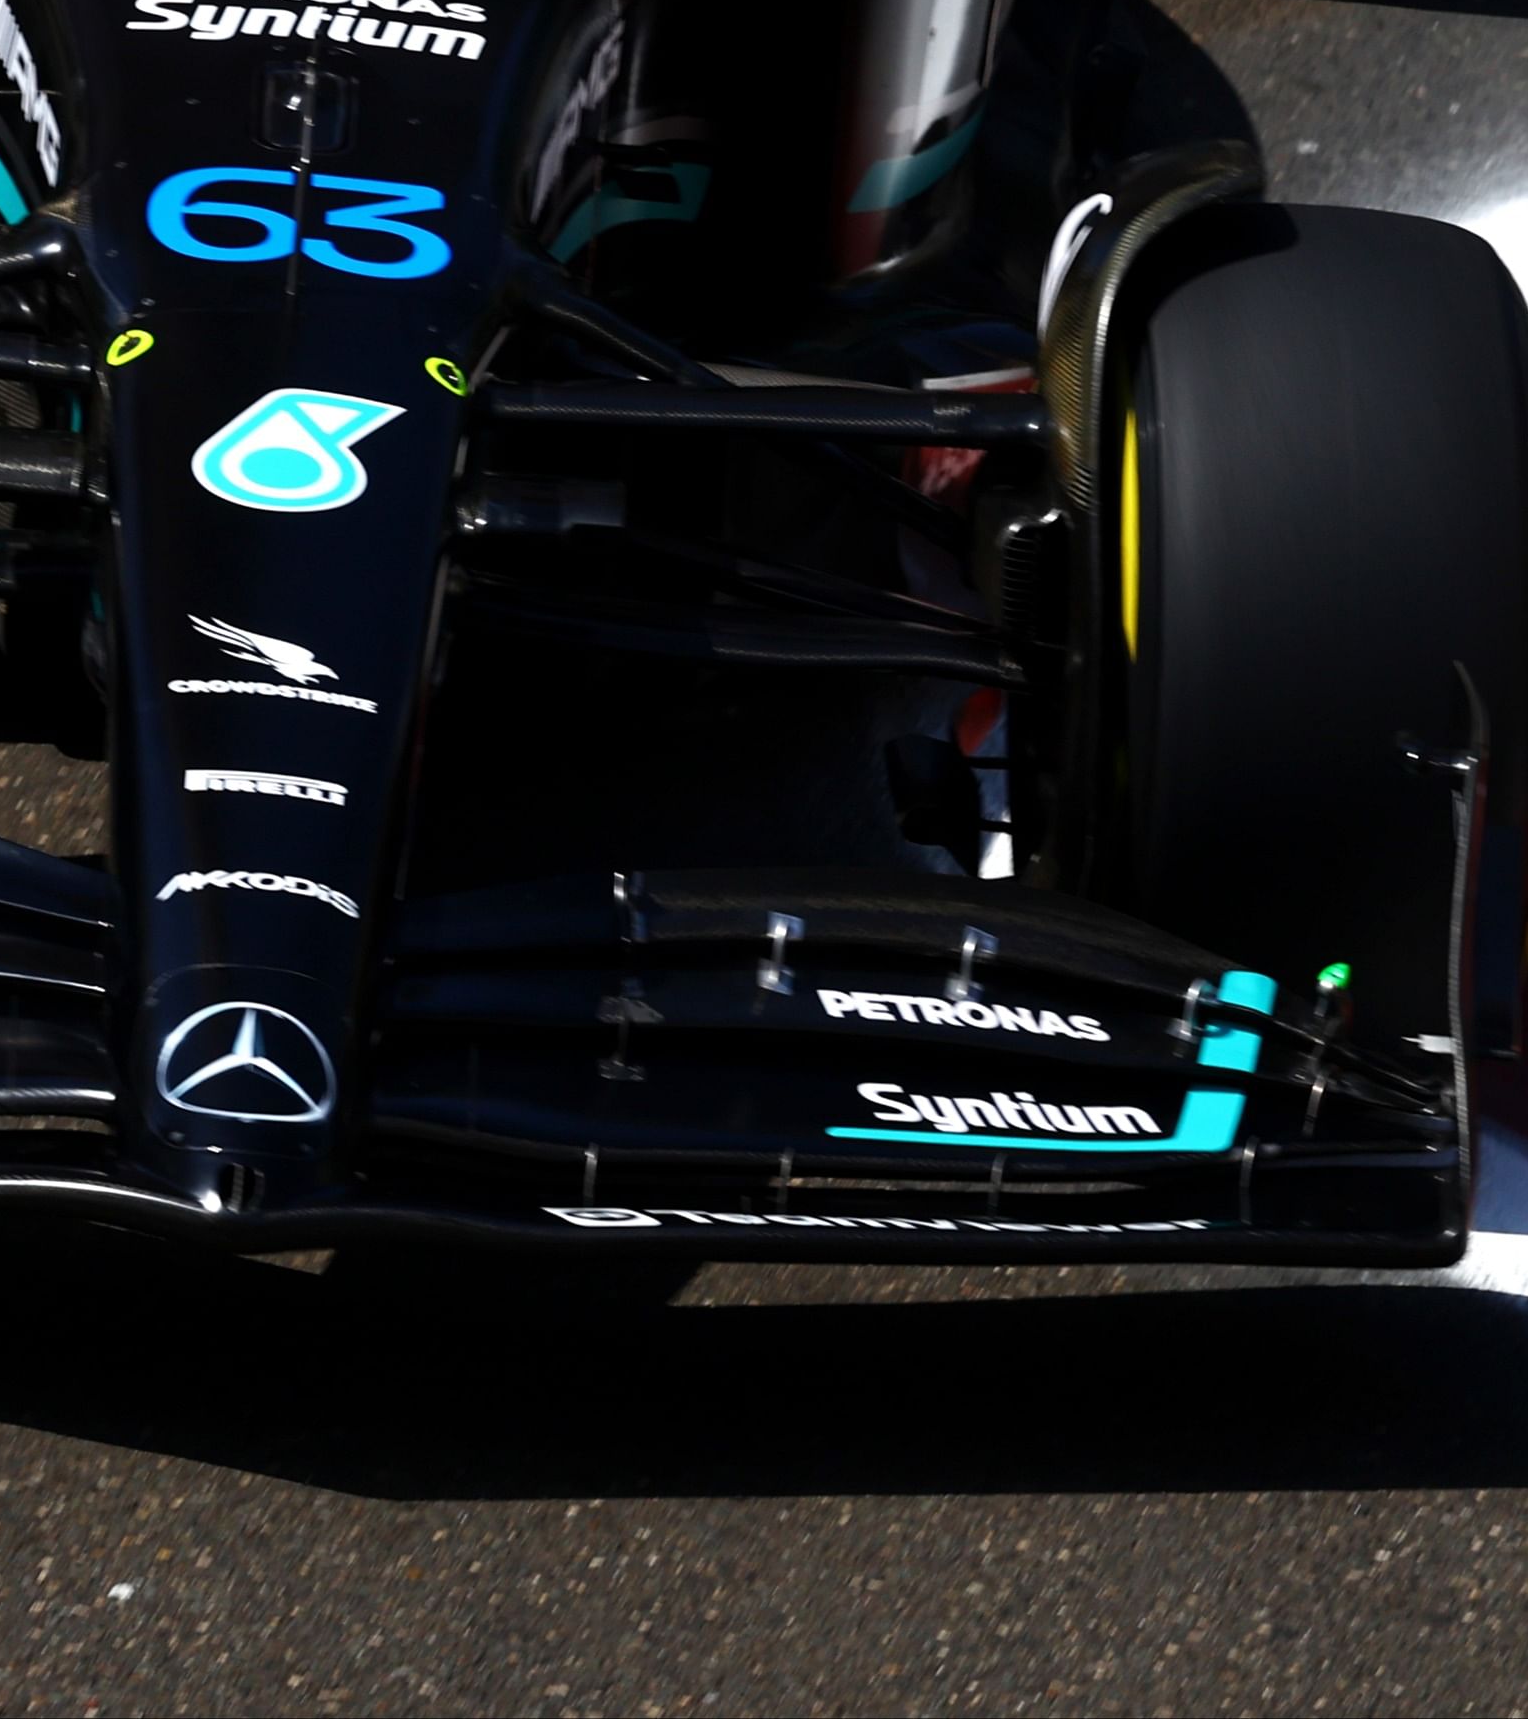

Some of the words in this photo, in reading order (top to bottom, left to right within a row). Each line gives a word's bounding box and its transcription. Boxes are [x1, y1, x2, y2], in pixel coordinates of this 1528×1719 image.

[146, 166, 453, 280] 63
[167, 678, 379, 714] CROWDSTRIKE
[183, 768, 349, 807] PIRELLI
[816, 987, 1111, 1043] PETRONAS
[857, 1082, 1162, 1135] Syntium
